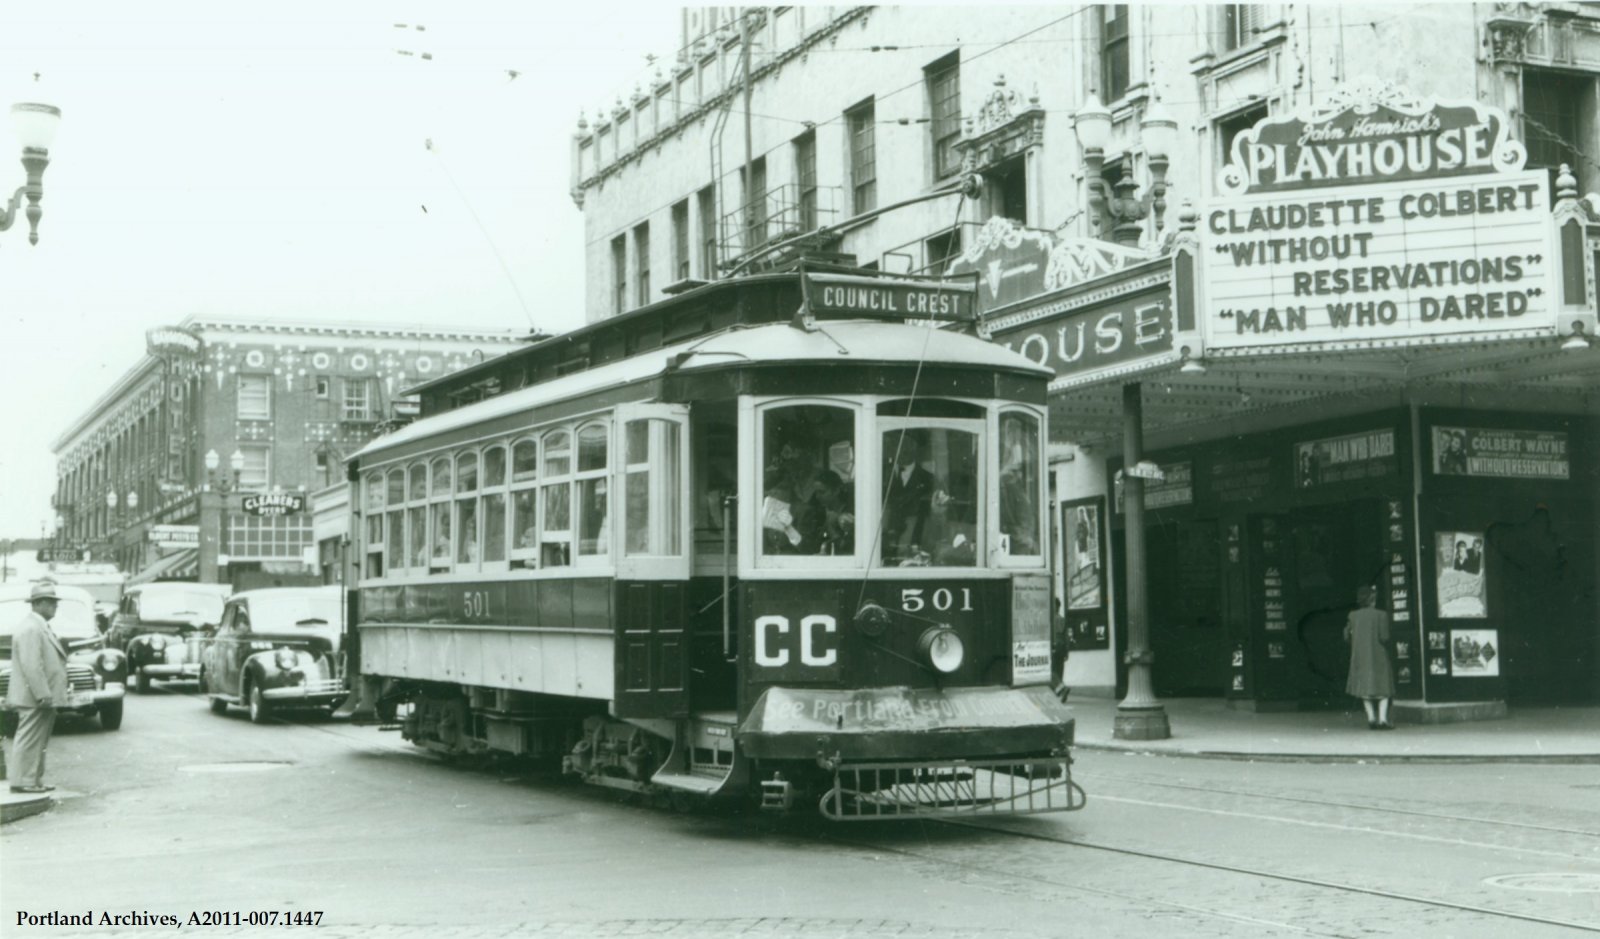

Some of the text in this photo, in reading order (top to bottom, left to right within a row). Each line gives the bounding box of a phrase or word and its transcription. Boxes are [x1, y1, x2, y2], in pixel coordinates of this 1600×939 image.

[1298, 121, 1345, 146] John
[1249, 122, 1491, 186] PLAYHOUSE
[1209, 183, 1541, 234] CLAUDETTE COLBERT
[1215, 232, 1373, 267] "WITHOUT
[1293, 254, 1542, 297] RESERVATIONS"
[824, 286, 960, 315] COUNCIL CREST
[1219, 288, 1542, 334] "MAN WHO DARED"
[1003, 300, 1165, 368] OUSE
[1471, 436, 1566, 454] COLBERT WAYNE
[1471, 457, 1569, 476] WITHOUT RESERVATIONS
[244, 494, 301, 510] CLEANERS
[464, 591, 490, 618] 501
[901, 588, 974, 612] 501
[765, 698, 805, 721] See
[813, 698, 915, 722] Portland
